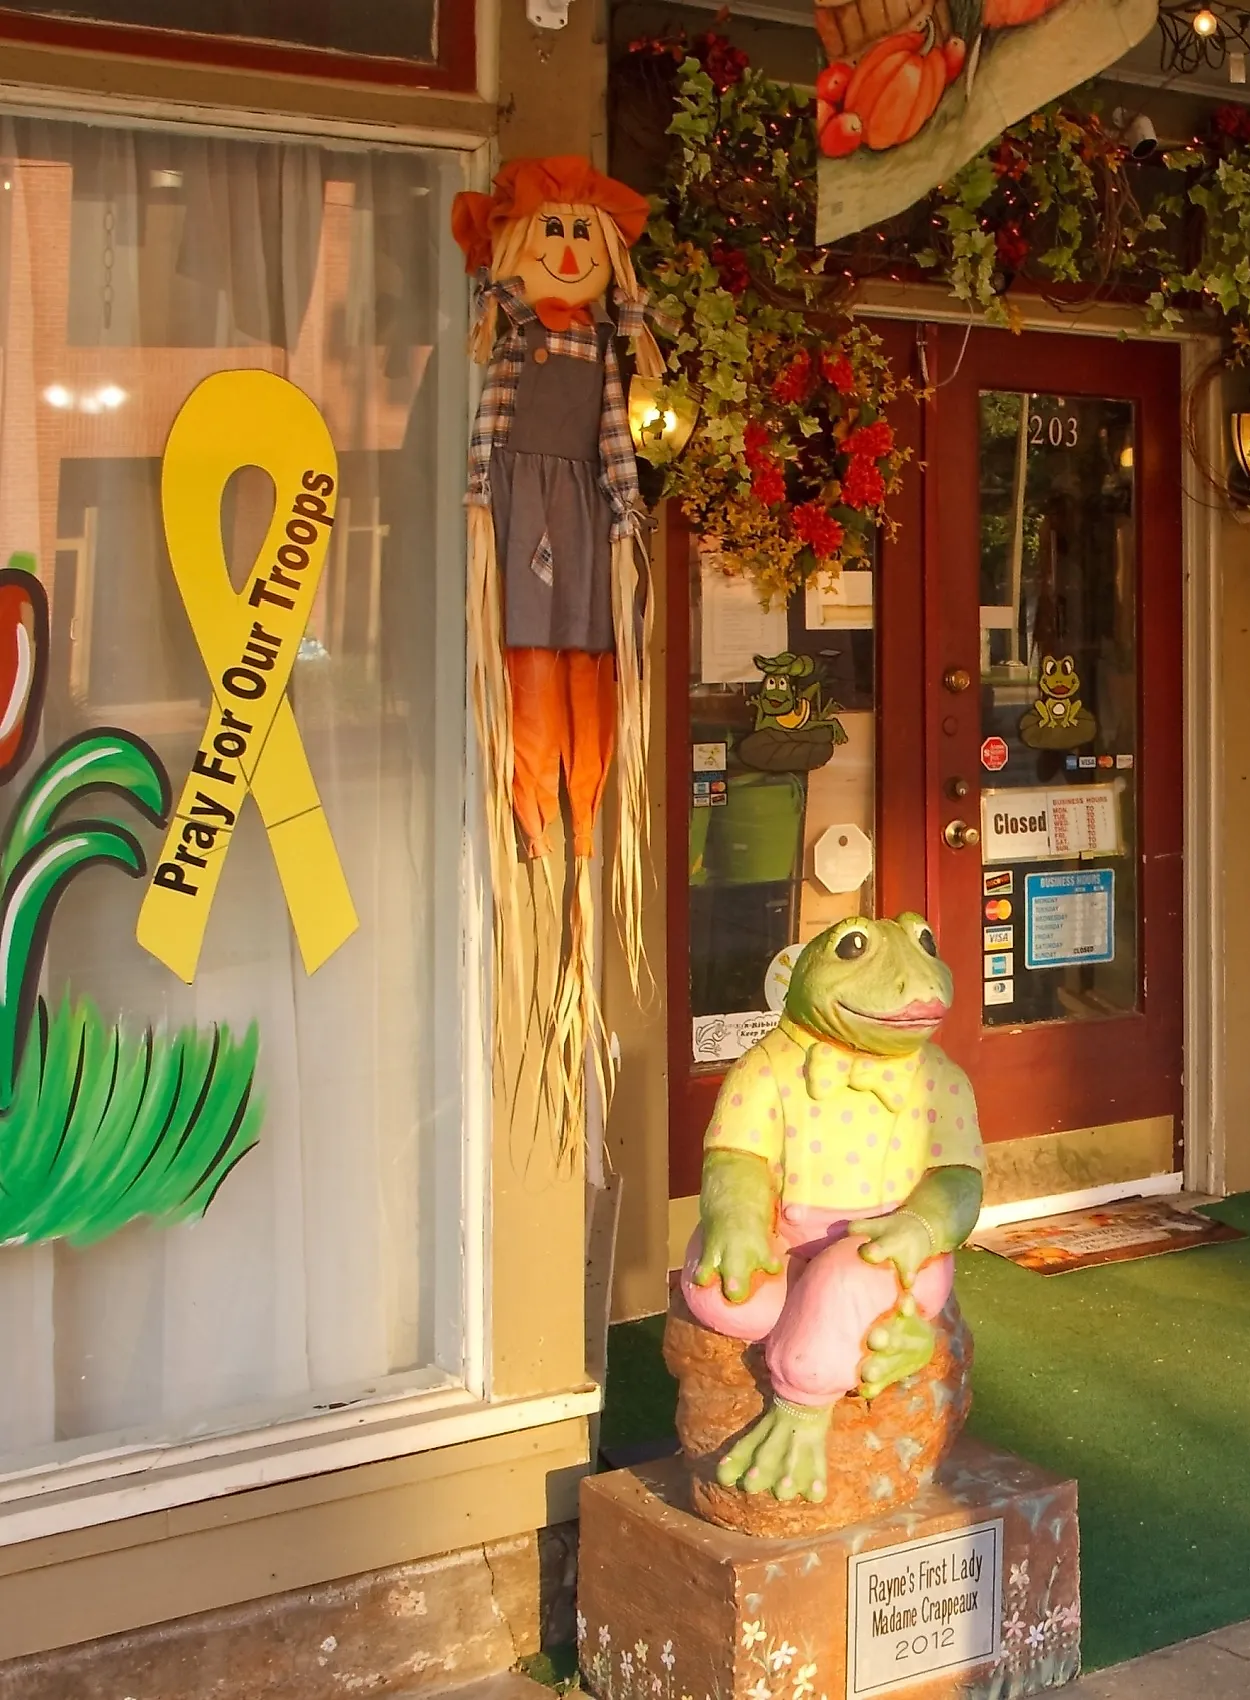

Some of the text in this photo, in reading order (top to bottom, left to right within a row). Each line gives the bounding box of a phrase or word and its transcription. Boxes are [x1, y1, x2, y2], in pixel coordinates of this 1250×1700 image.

[1029, 415, 1078, 448] 203
[152, 468, 336, 897] Pray For Our Troops
[1052, 796, 1108, 806] BUSINESS HOURS
[993, 811, 1047, 836] Closed
[1041, 874, 1101, 888] BUSINESS HOURS
[989, 933, 1009, 944] VISA
[1073, 945, 1095, 955] CLOSED
[868, 1548, 983, 1607] Rayne's First Lady
[872, 1590, 978, 1638] Madame Crappeaux
[895, 1627, 955, 1661] 2012
